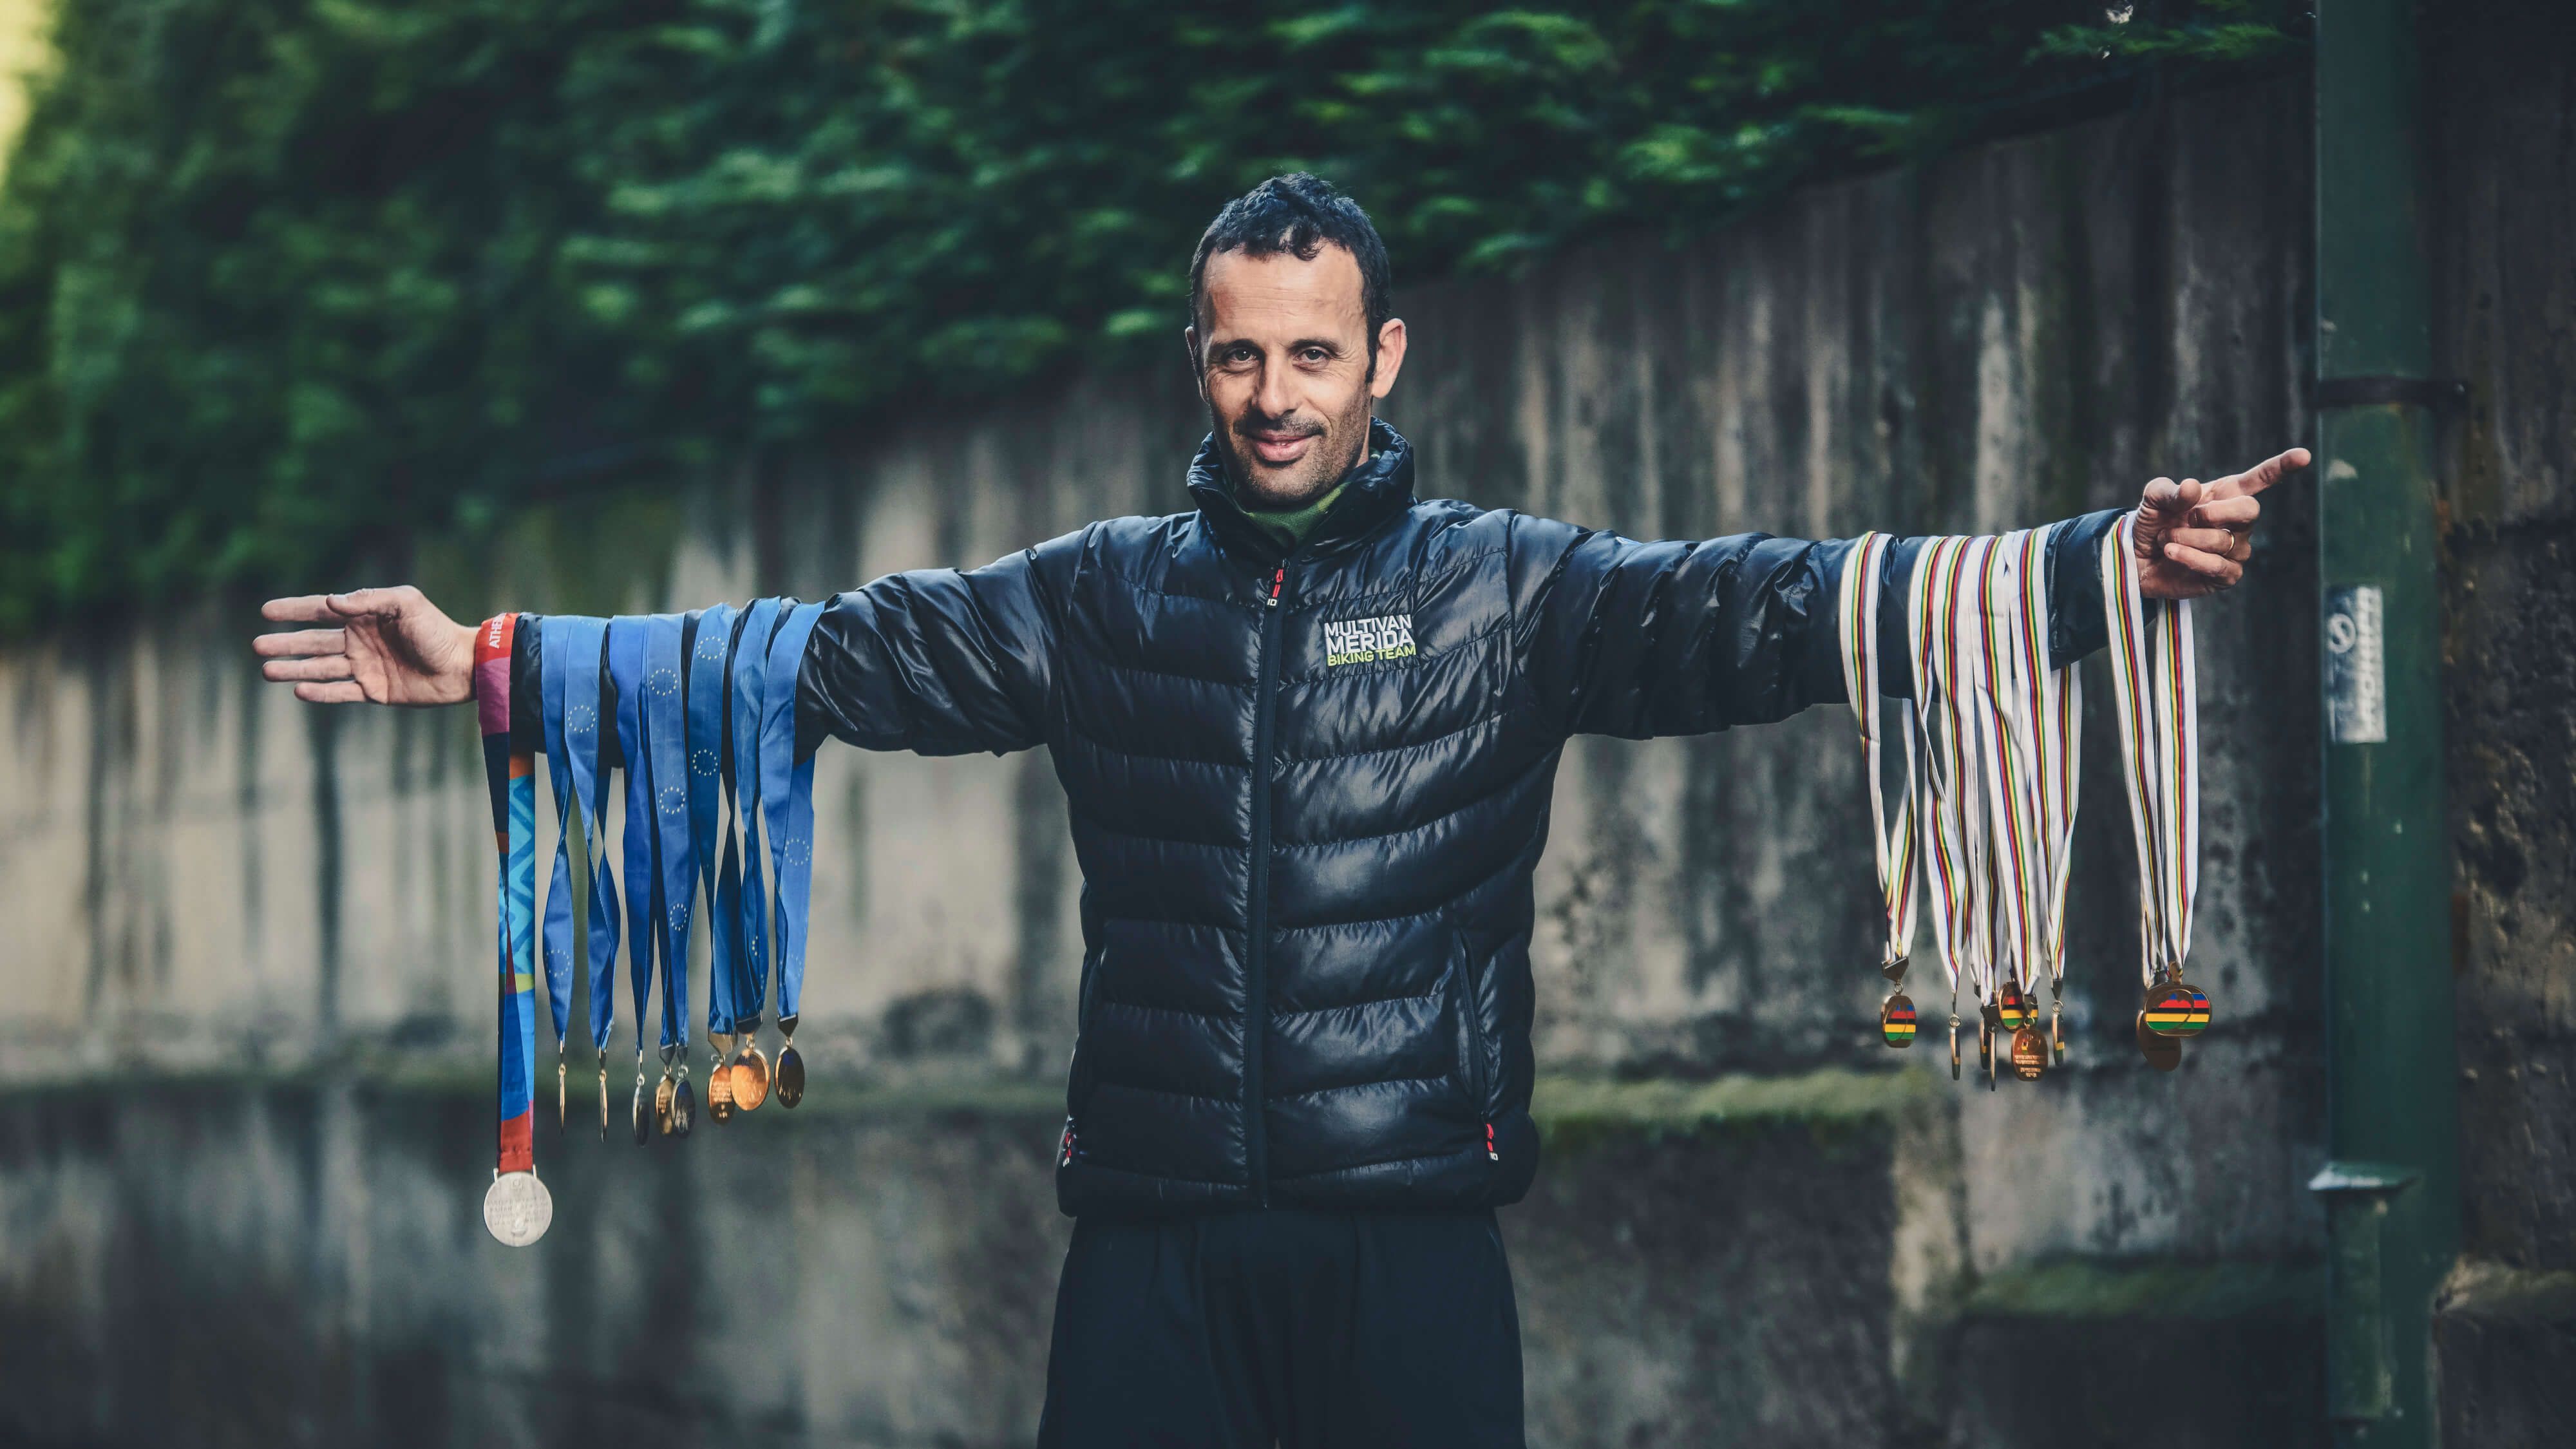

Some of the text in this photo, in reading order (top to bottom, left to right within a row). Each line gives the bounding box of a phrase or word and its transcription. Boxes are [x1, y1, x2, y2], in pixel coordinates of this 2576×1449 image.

[1324, 614, 1412, 638] MULTIVAN
[1327, 628, 1416, 655] MERIDA
[1327, 645, 1417, 667] BIKING TEAM
